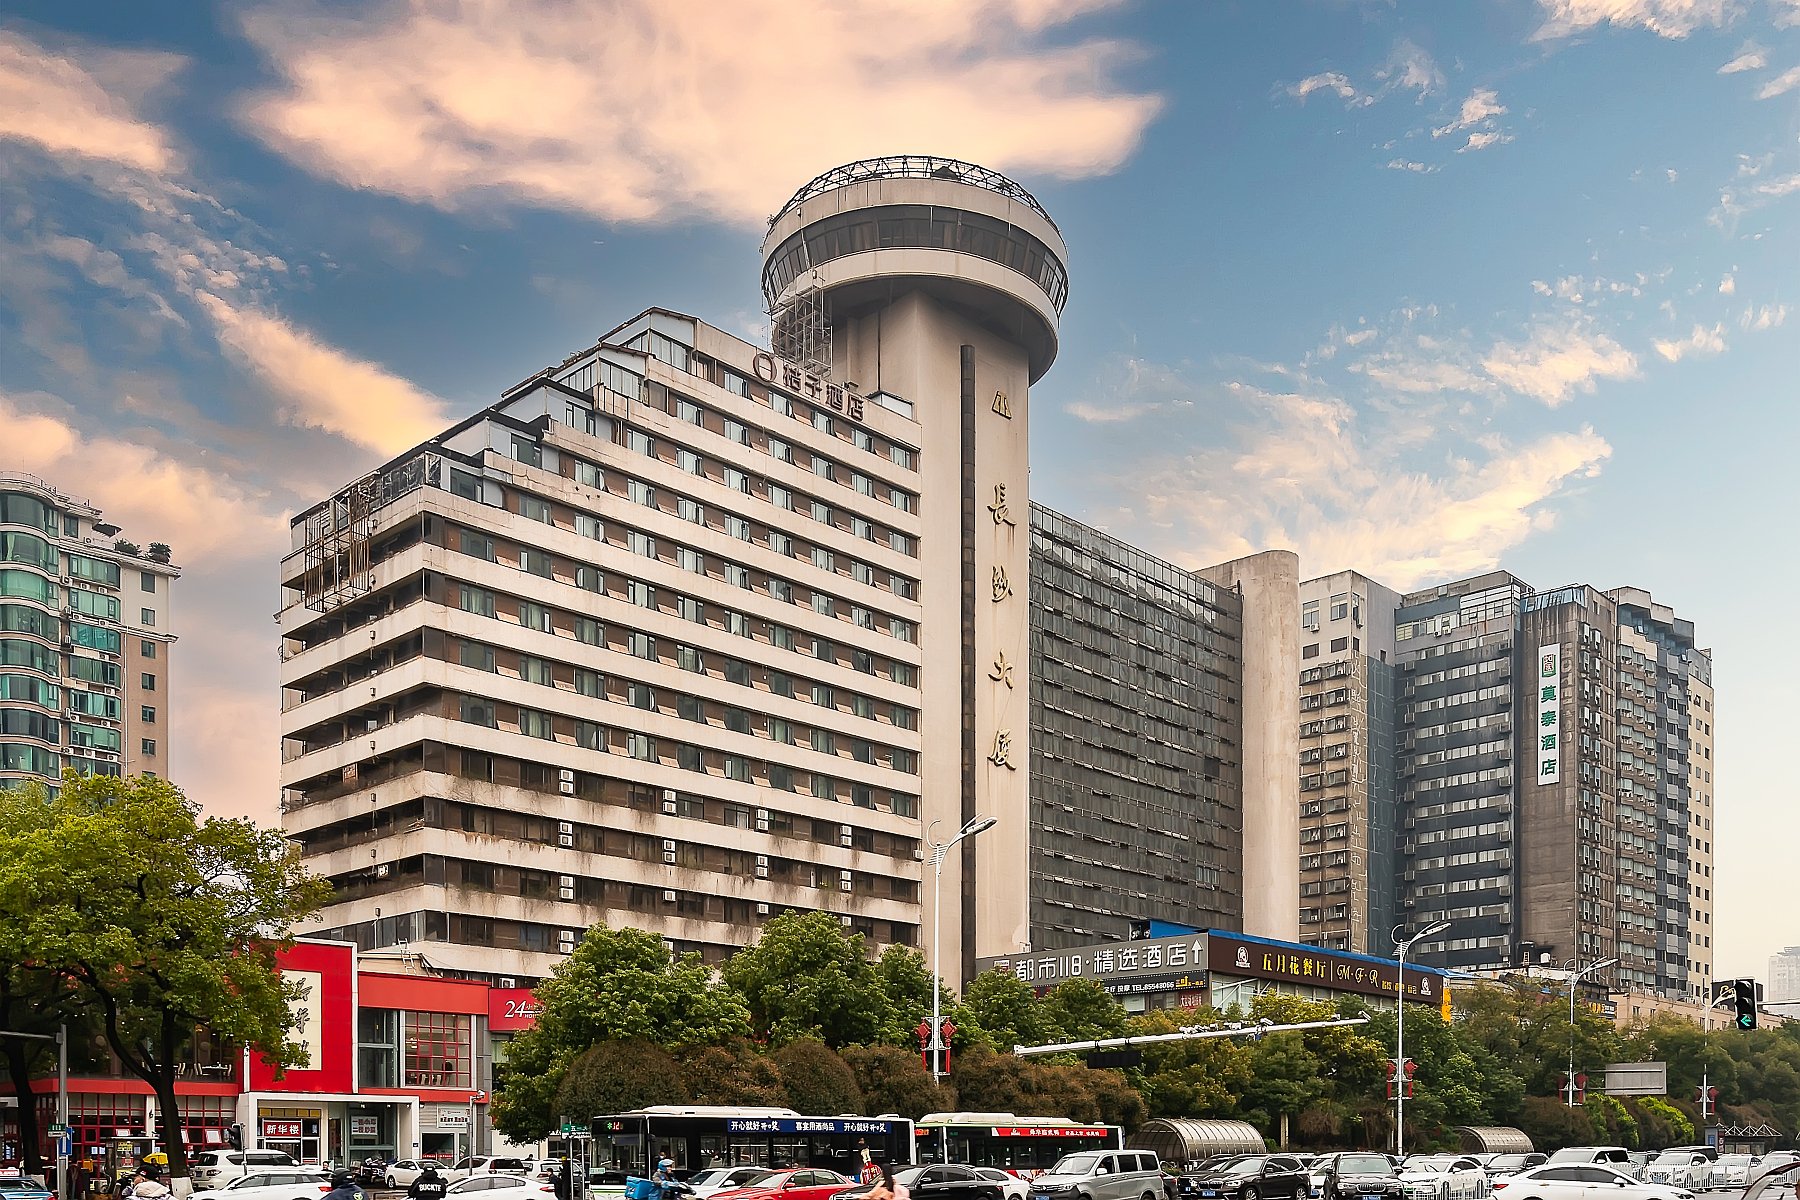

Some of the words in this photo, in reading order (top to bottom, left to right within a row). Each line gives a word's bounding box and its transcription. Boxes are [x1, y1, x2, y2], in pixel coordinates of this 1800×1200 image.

[783, 364, 864, 422] 桔子酒店
[1540, 685, 1557, 776] 莫泰酒店
[1262, 953, 1327, 978] 五月花餐厅
[504, 1000, 526, 1018] 24
[266, 1124, 299, 1135] 新华楼
